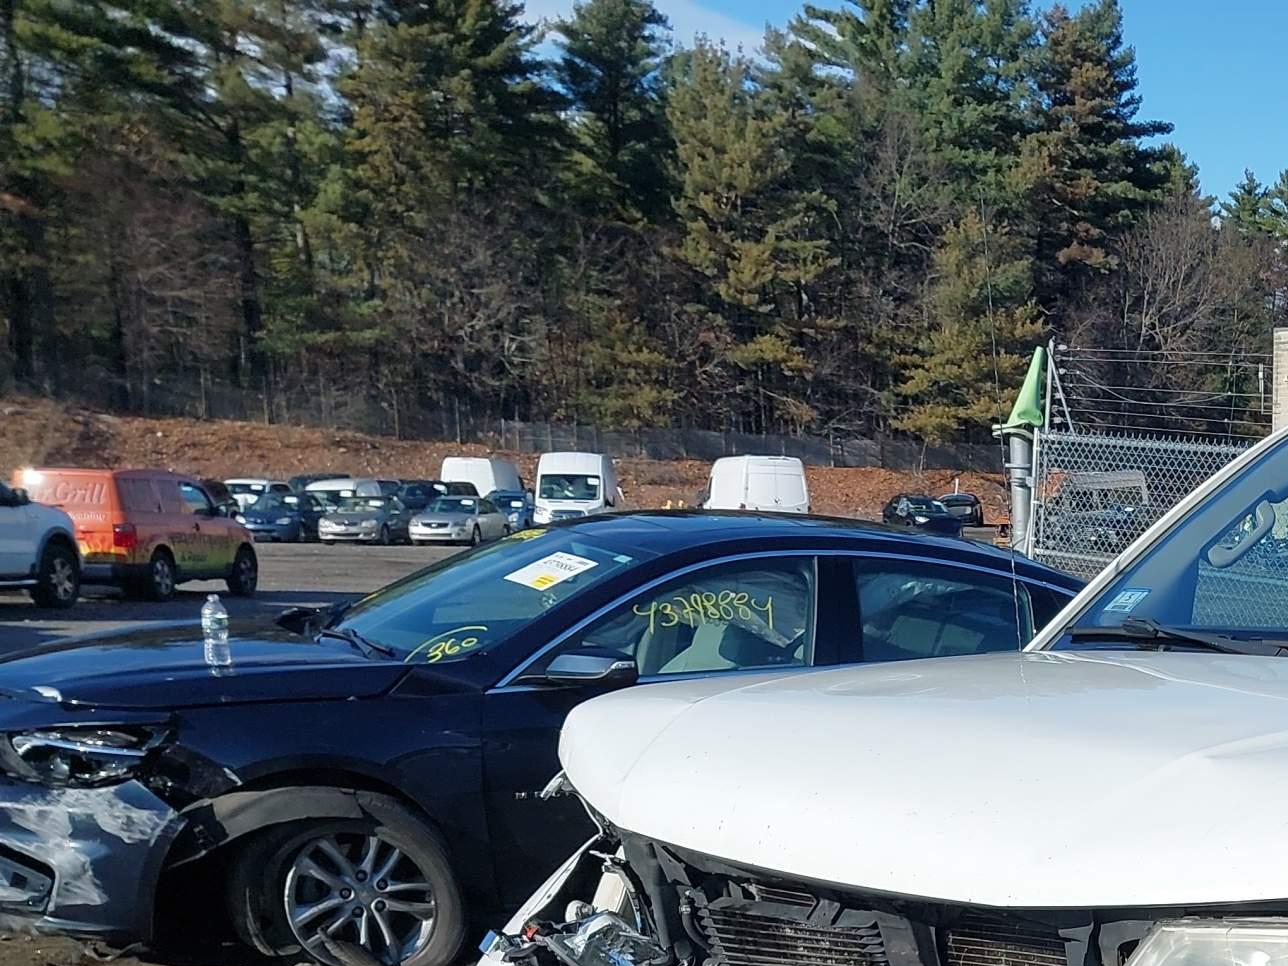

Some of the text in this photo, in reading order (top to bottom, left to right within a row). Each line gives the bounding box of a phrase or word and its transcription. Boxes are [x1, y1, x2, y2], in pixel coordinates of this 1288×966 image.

[55, 480, 107, 504] Grill
[632, 590, 773, 635] 43798884
[426, 637, 478, 664] 360
